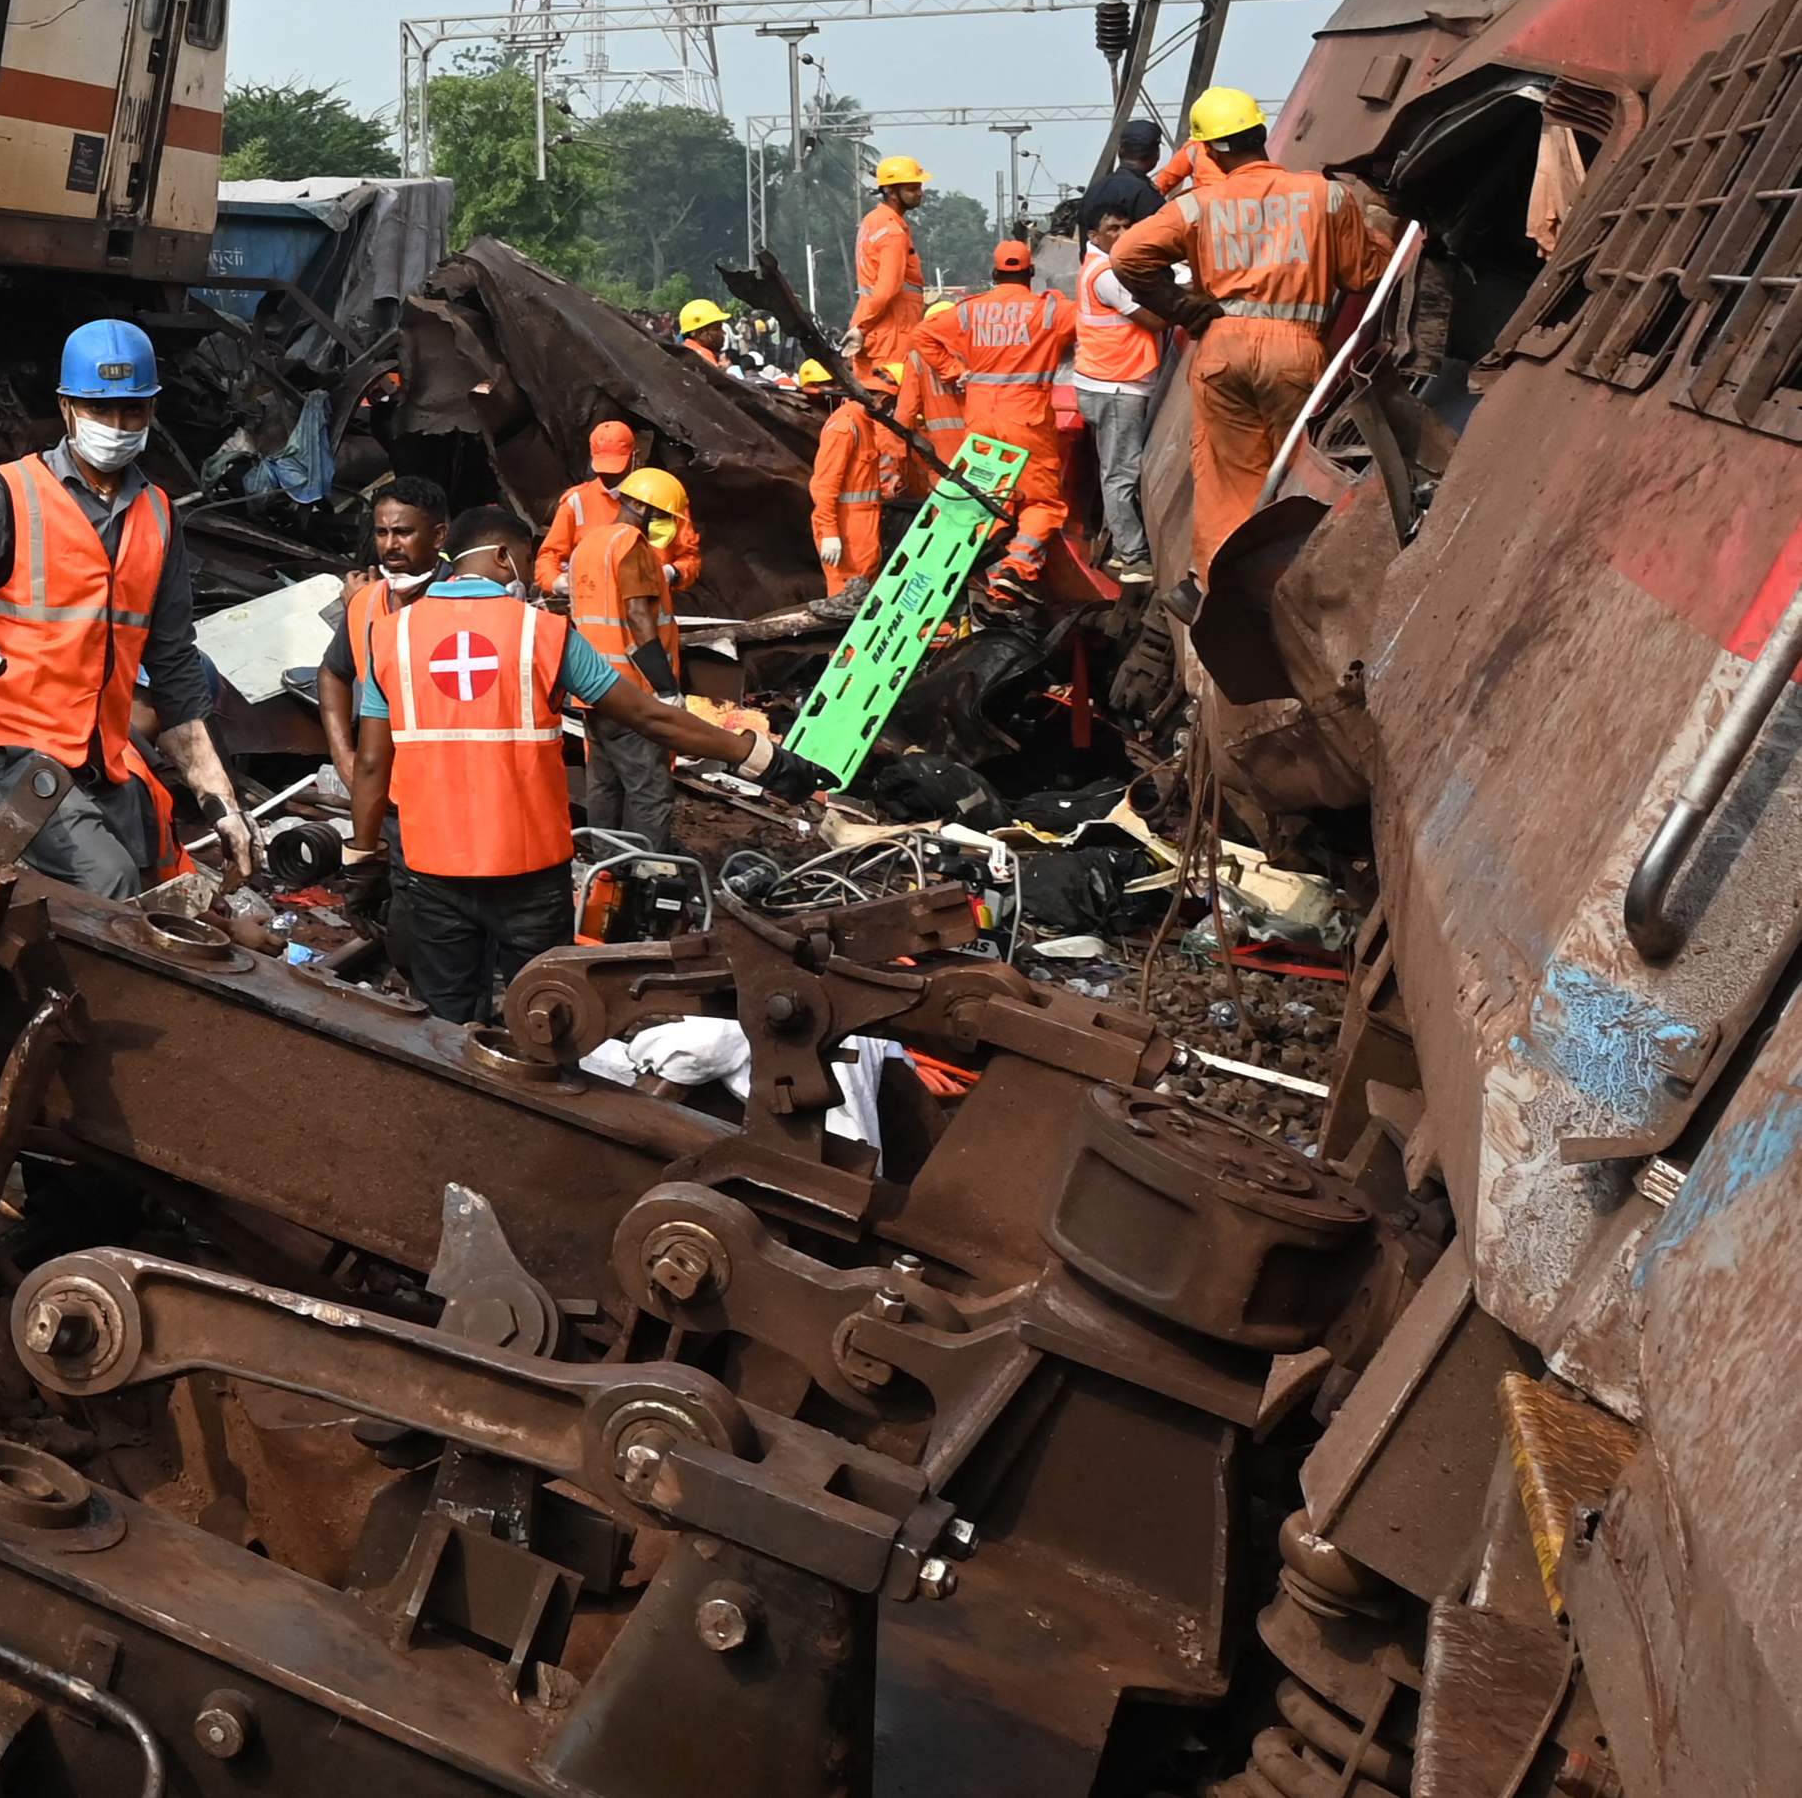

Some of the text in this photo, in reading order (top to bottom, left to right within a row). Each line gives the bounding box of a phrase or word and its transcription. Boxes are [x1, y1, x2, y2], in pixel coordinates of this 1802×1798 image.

[1209, 191, 1310, 235] NDRF
[1212, 226, 1310, 271] INDIA
[971, 301, 1036, 323] NDRF
[971, 322, 1031, 347] INDIA
[898, 570, 933, 612] ULTRA
[871, 609, 905, 665] BAK-PAK
